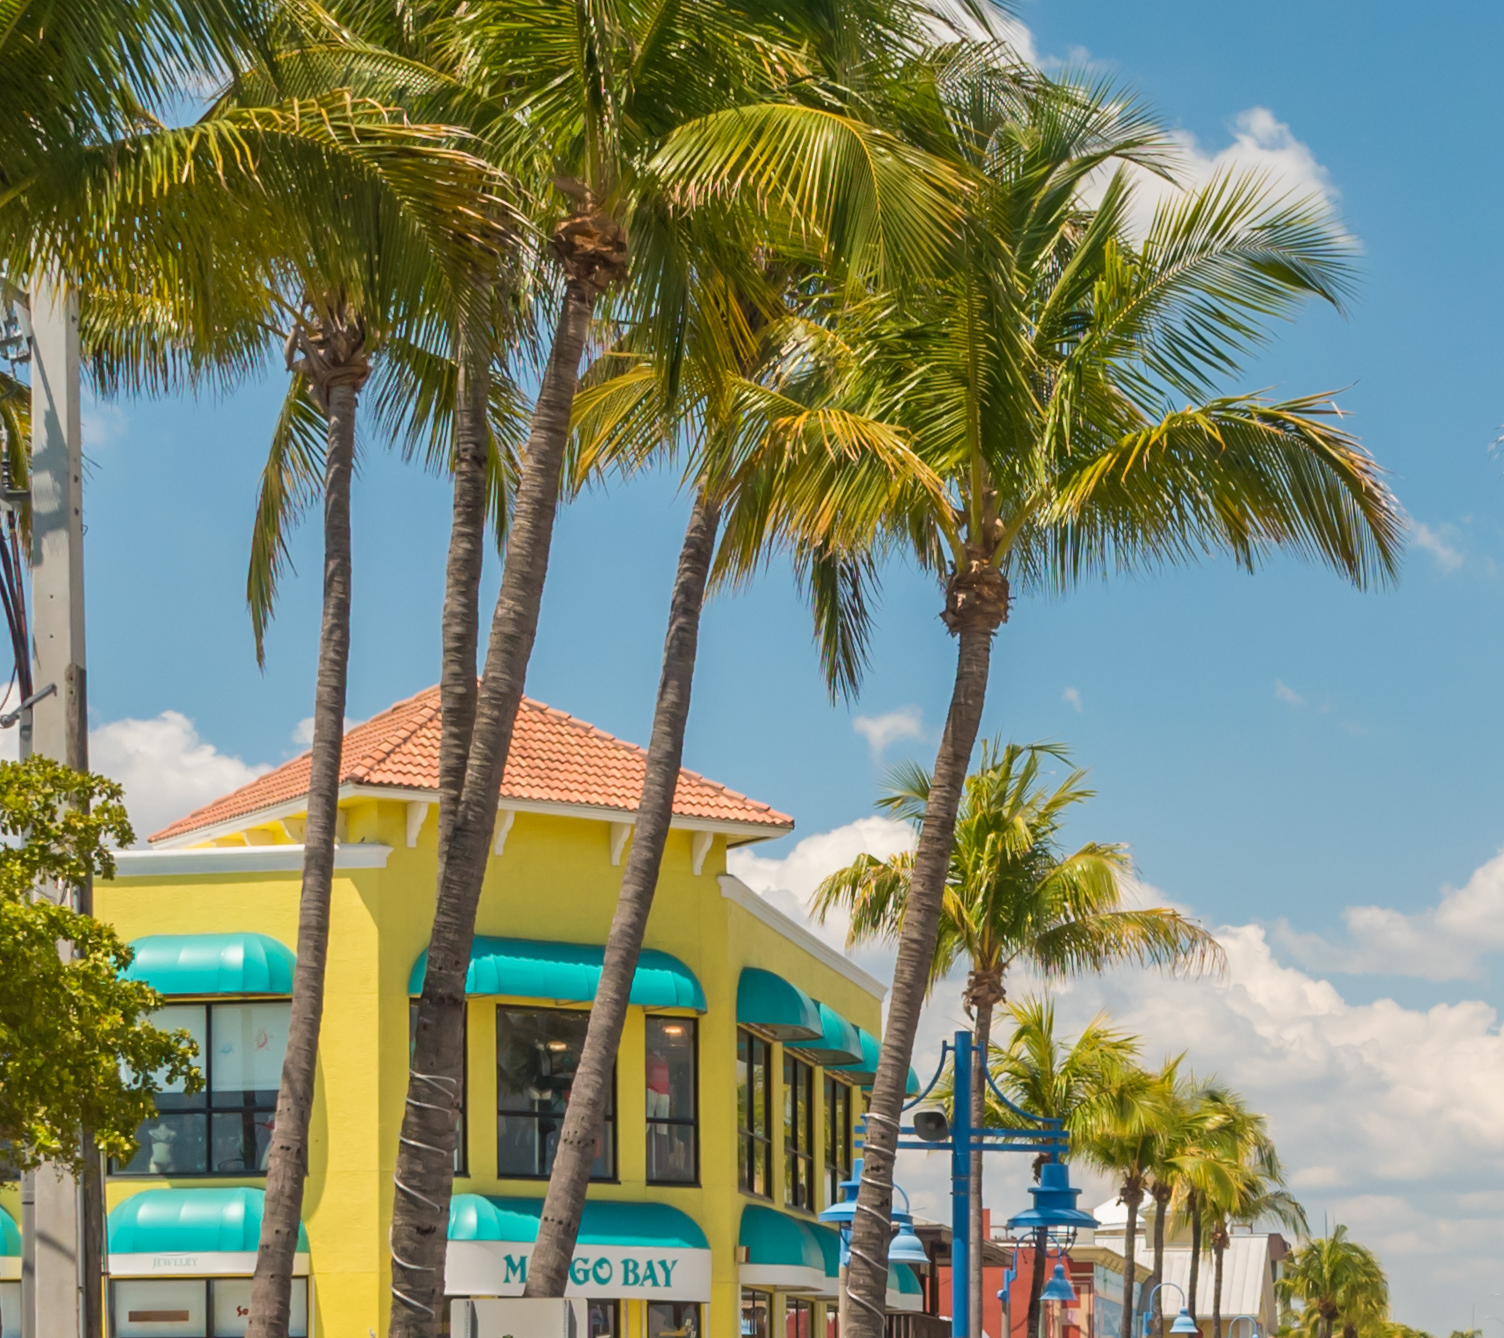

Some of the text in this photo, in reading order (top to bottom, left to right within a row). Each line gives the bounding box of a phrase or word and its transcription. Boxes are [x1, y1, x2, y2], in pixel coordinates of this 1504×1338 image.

[152, 1257, 199, 1269] JEWELRY
[503, 1253, 679, 1288] MGO BAY
